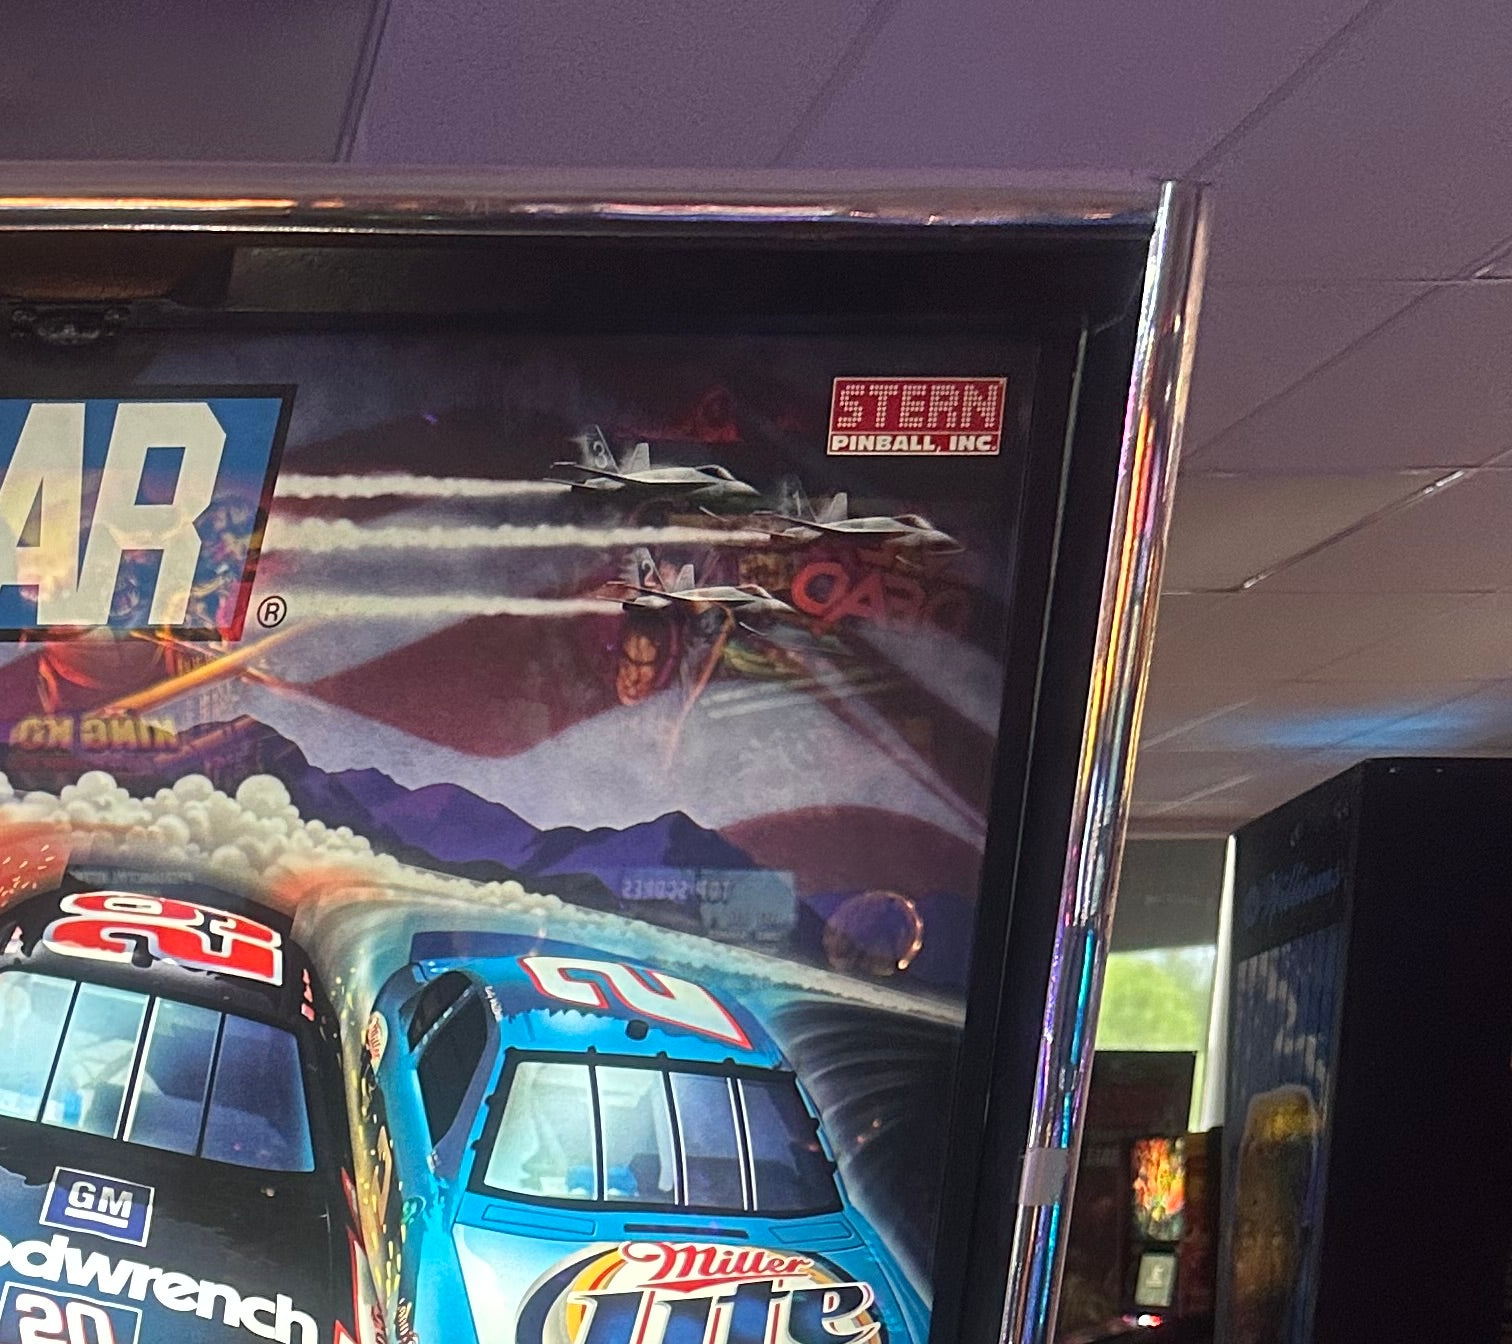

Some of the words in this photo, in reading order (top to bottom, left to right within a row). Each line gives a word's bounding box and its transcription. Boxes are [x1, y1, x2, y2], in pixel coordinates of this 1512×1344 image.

[836, 384, 1000, 428] STERN
[831, 433, 943, 454] PINBALL,
[948, 433, 999, 452] INC.
[43, 890, 284, 986] 29
[520, 956, 755, 1050] 2
[68, 1180, 131, 1217] GM
[621, 1240, 813, 1286] Miller
